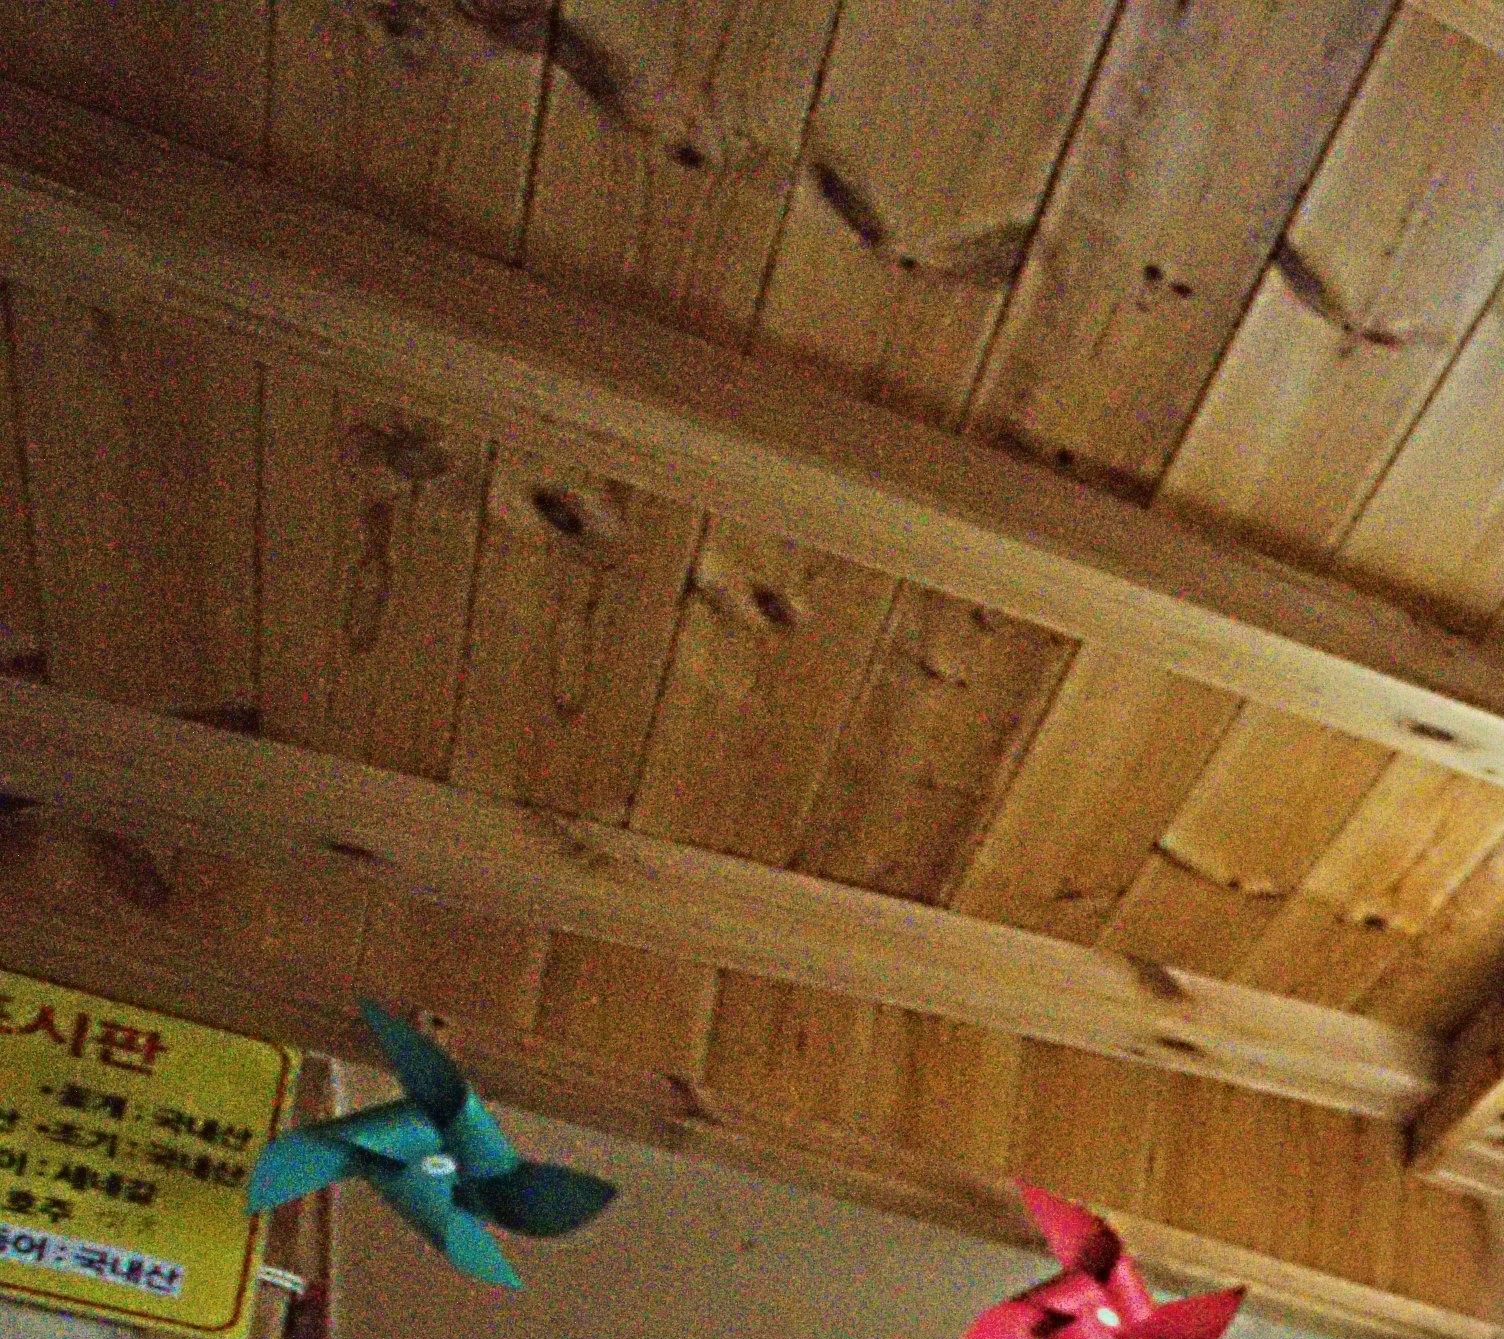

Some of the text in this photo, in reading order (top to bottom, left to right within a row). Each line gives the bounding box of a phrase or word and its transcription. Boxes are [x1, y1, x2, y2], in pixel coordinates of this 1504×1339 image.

[153, 1107, 253, 1150] 국내산
[148, 1142, 246, 1188] 국내산
[5, 1188, 73, 1223] 호주
[73, 1245, 182, 1293] 국내산
